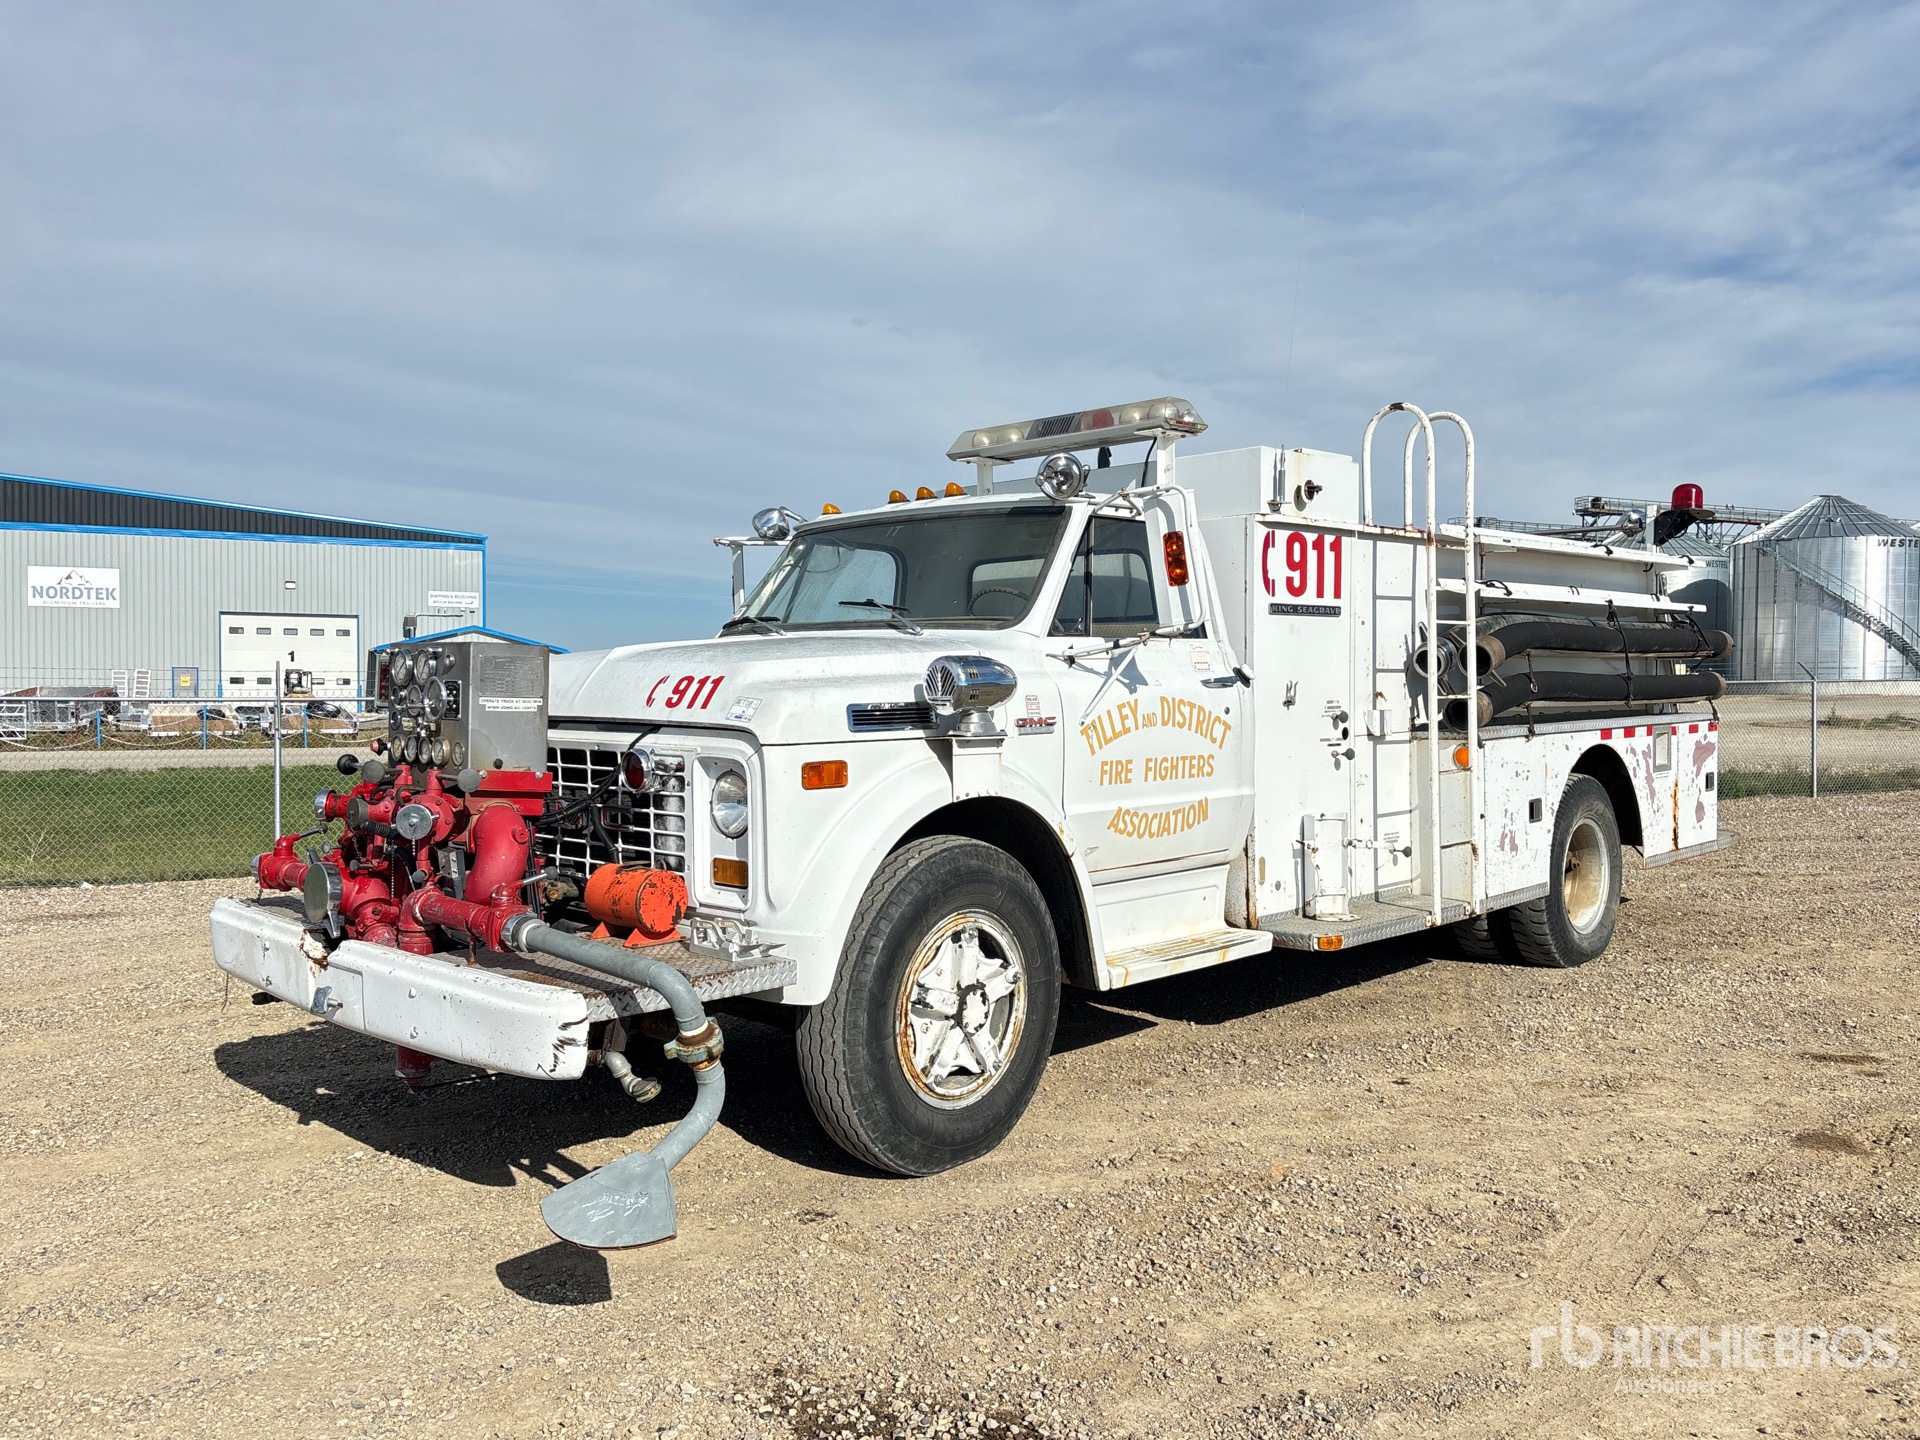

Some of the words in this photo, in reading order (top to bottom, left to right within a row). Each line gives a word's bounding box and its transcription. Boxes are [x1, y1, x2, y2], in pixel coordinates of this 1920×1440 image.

[1286, 531, 1342, 599] 911
[31, 585, 117, 601] NORDTEK
[1271, 604, 1294, 613] KING
[1297, 605, 1341, 615] SEAGRAVE
[287, 650, 295, 662] 1
[665, 675, 726, 709] 911
[1014, 717, 1057, 728] GMC
[1080, 698, 1140, 756] TILLEY
[1142, 712, 1158, 729] AND
[1159, 696, 1232, 750] DISTRICT
[1099, 759, 1134, 786] FIRE
[1144, 754, 1215, 782] FIGHTERS
[1106, 796, 1209, 839] ASSOCIATION
